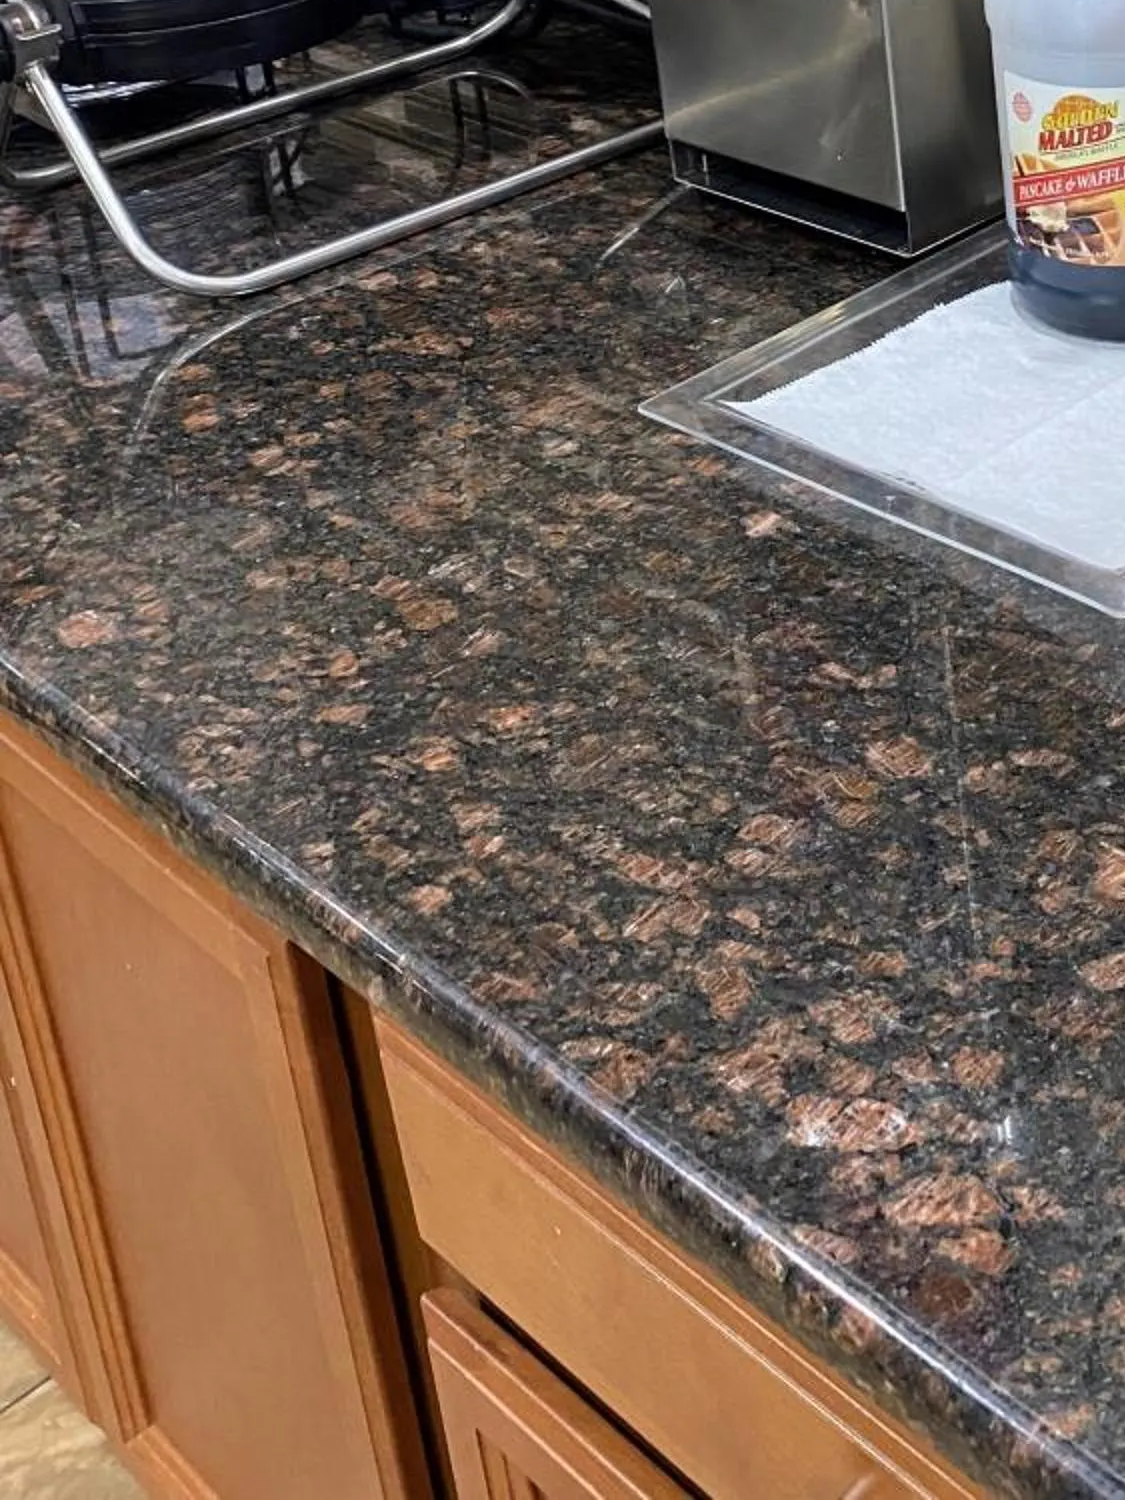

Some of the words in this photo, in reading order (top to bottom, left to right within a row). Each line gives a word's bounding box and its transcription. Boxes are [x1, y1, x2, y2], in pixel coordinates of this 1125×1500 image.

[1041, 99, 1120, 132] GOLDEN
[1038, 120, 1113, 151] MALTED
[1018, 178, 1063, 200] PANCAKE
